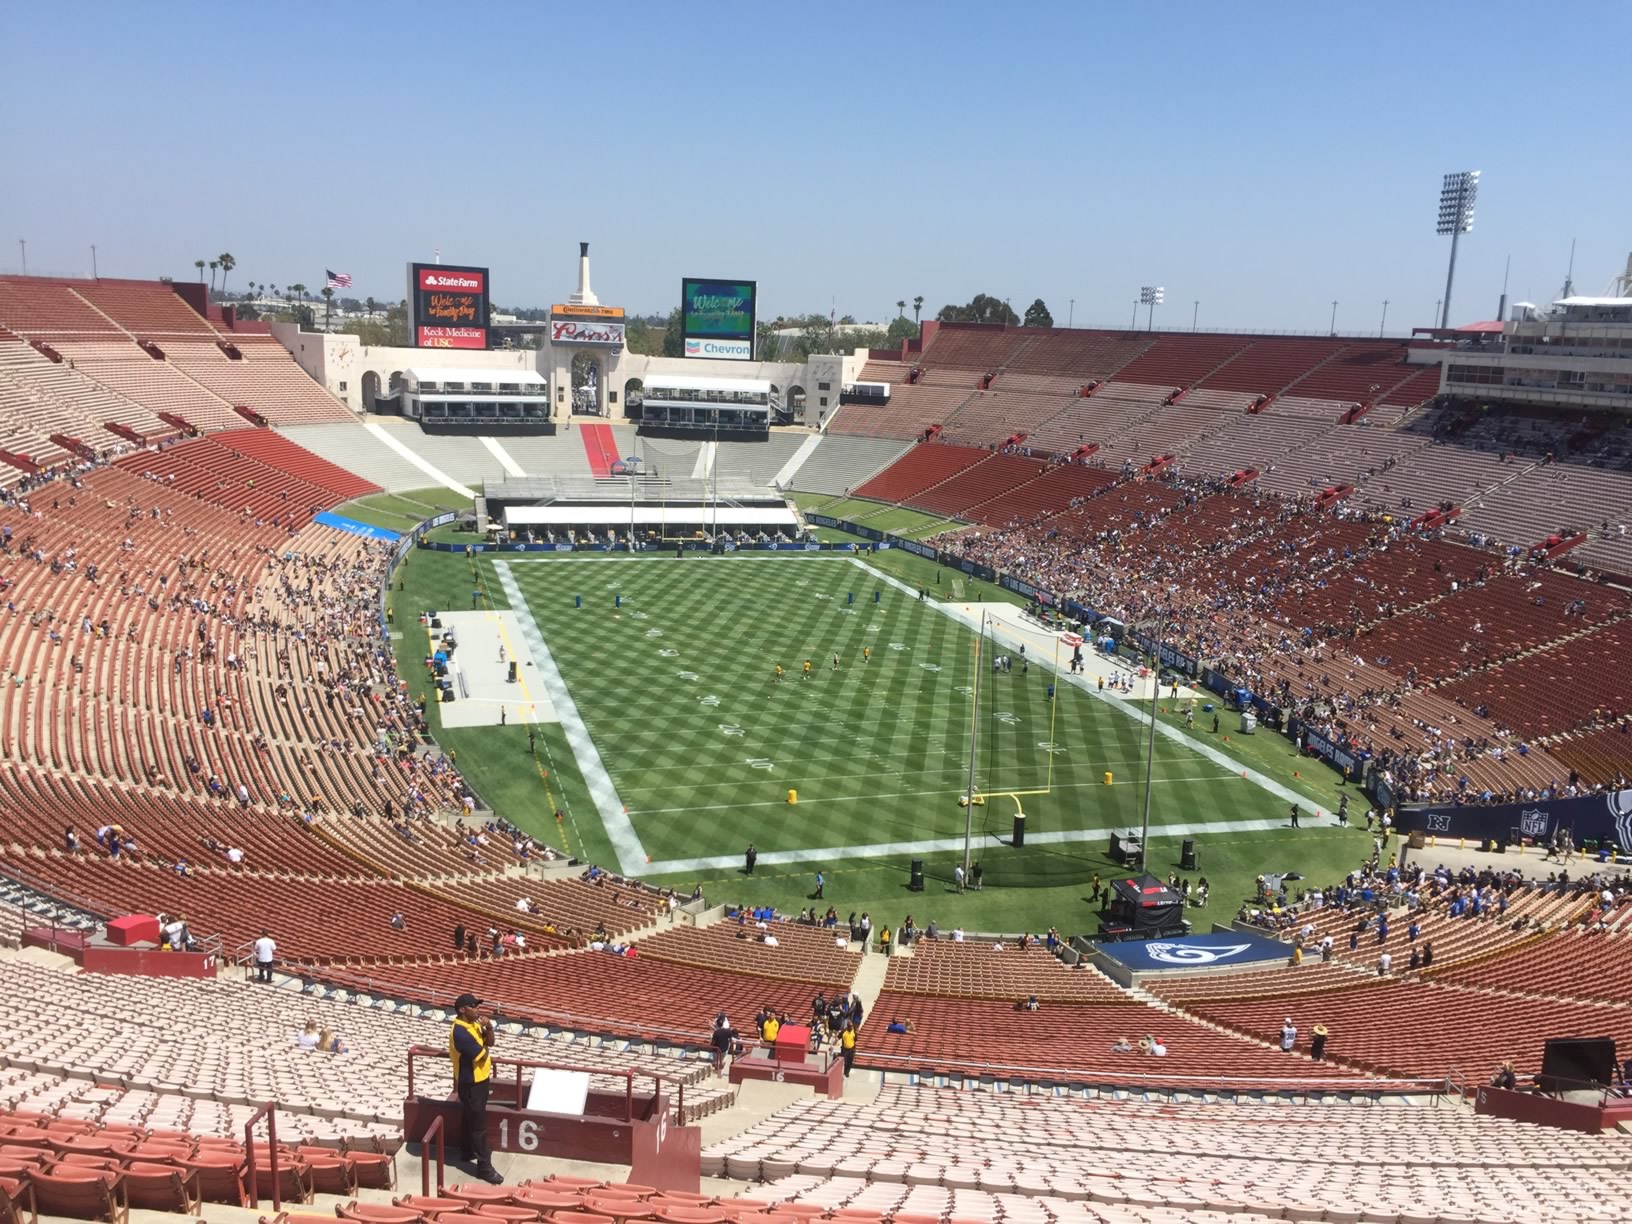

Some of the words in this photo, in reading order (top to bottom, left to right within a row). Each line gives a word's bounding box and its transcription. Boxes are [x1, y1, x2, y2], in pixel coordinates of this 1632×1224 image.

[693, 295, 743, 308] Welcme
[424, 327, 444, 336] Keck
[446, 328, 481, 338] Medicine
[424, 338, 434, 346] of
[434, 338, 454, 347] USC
[704, 343, 750, 354] Chevron
[1524, 820, 1546, 834] NFL
[202, 955, 216, 970] 17
[771, 1071, 785, 1082] 16
[1476, 1088, 1488, 1105] 15
[498, 1118, 539, 1151] 16
[656, 1111, 668, 1154] 16
